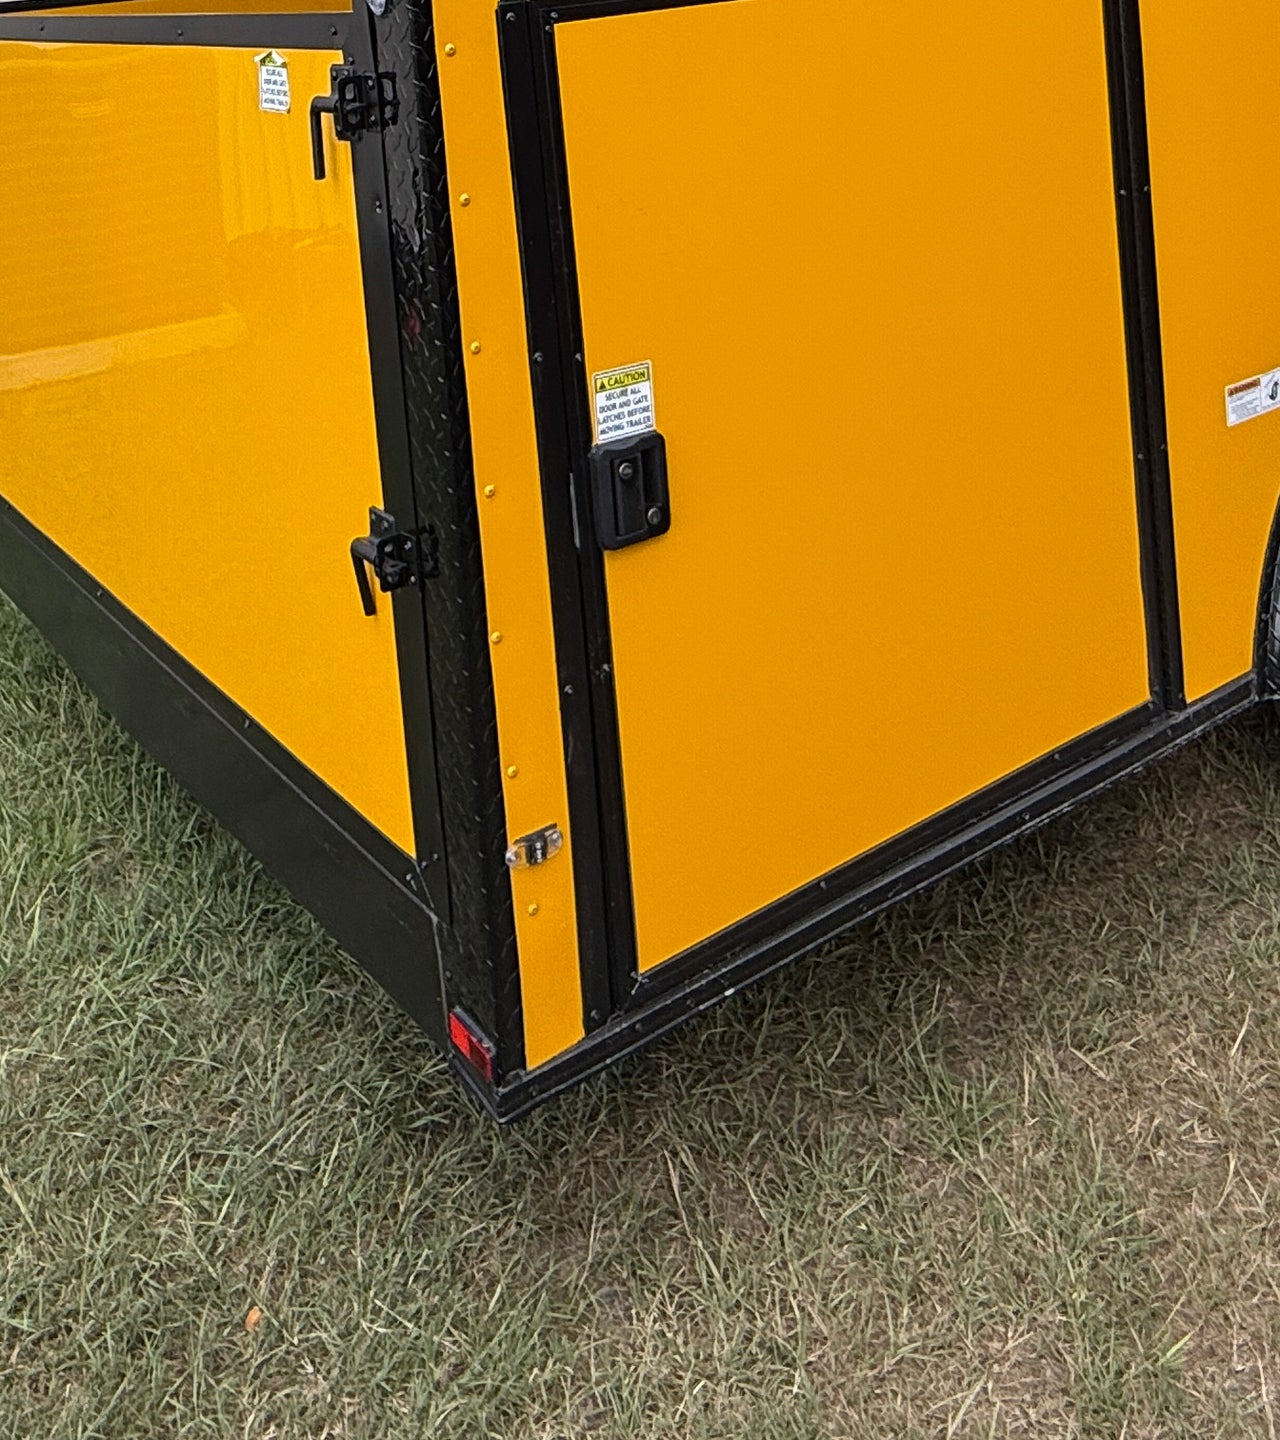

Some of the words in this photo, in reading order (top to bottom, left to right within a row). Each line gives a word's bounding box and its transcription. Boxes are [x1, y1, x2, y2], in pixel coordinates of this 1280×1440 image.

[607, 370, 646, 386] CAUTION
[605, 388, 628, 402] SECURE
[630, 387, 641, 395] ALL
[599, 403, 617, 414] DOOR
[618, 399, 631, 409] AND
[633, 395, 648, 405] GATE
[627, 405, 652, 418] BEFORE
[626, 416, 651, 428] TRAILER
